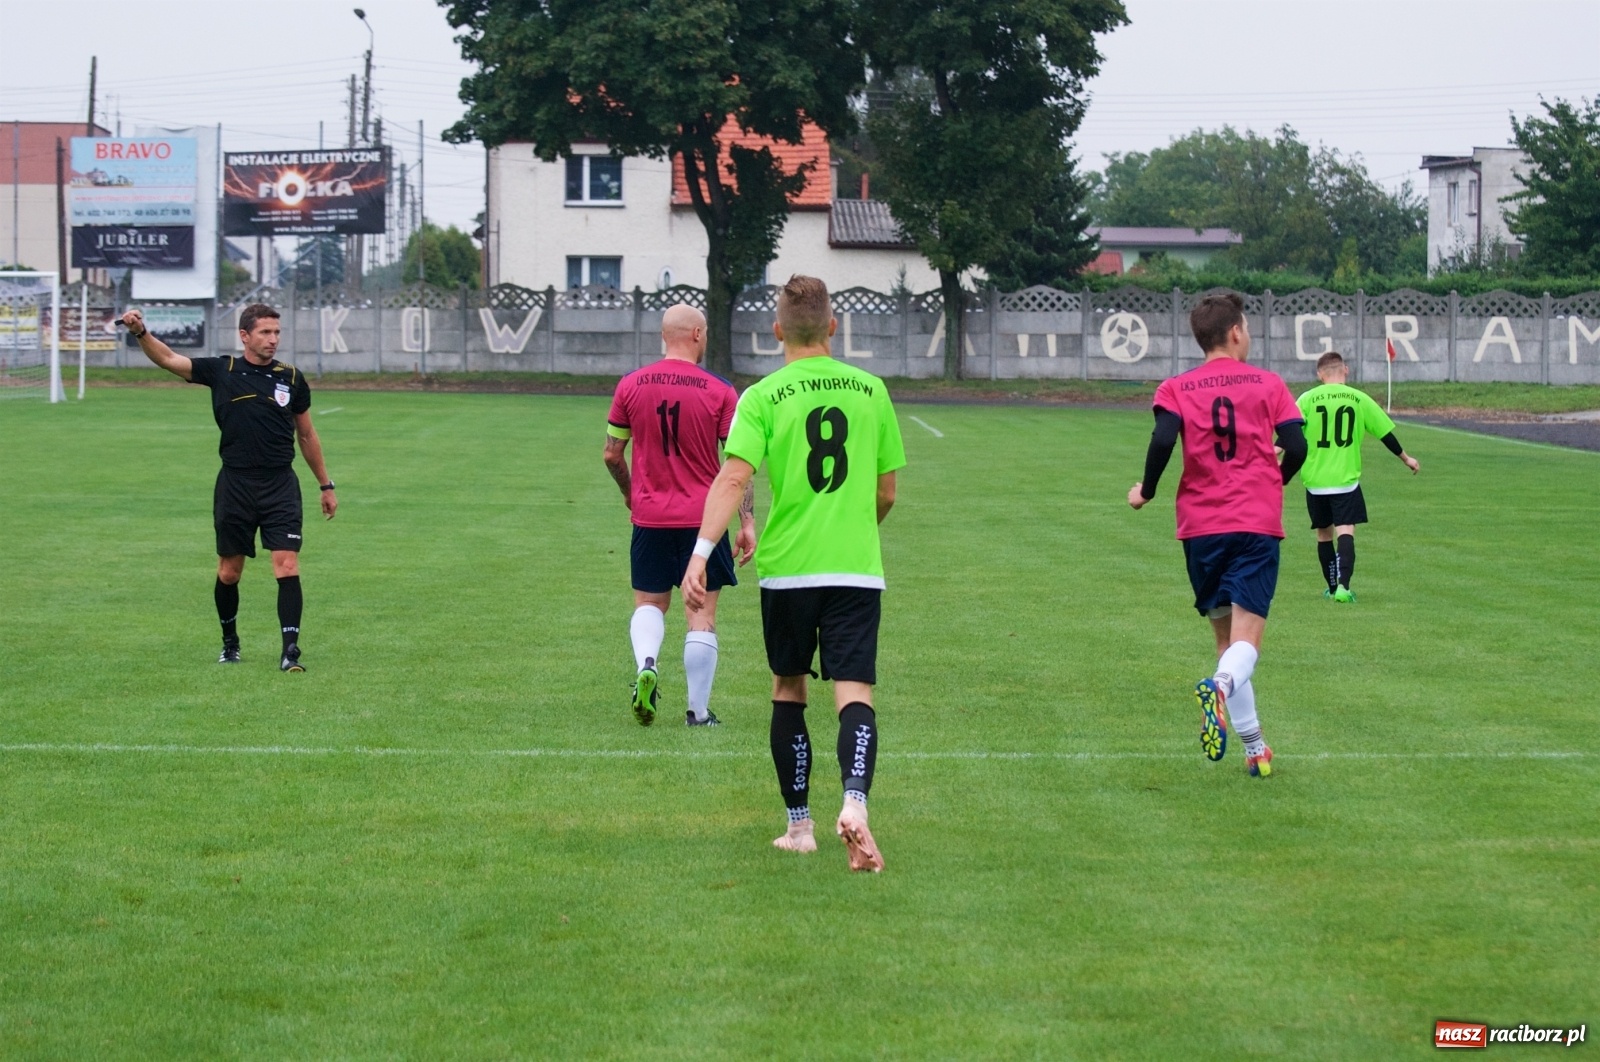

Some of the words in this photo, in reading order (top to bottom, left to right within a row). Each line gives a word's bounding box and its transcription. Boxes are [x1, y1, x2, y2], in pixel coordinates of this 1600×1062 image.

[96, 142, 171, 159] BRAVO
[228, 153, 300, 166] INSTALACJE
[301, 151, 381, 164] ELEKTRYCZNE
[636, 373, 649, 386] LKS
[651, 372, 708, 389] KRZYŻANOWICE
[771, 384, 795, 405] LKS
[798, 376, 873, 398] TWORKÓW
[1180, 382, 1196, 391] LKS
[1198, 374, 1263, 388] KRZYŻANOWICE
[1312, 393, 1325, 404] LKS
[656, 399, 680, 456] 11
[1211, 396, 1237, 462] 9
[1316, 405, 1355, 448] 10
[805, 405, 848, 494] 8
